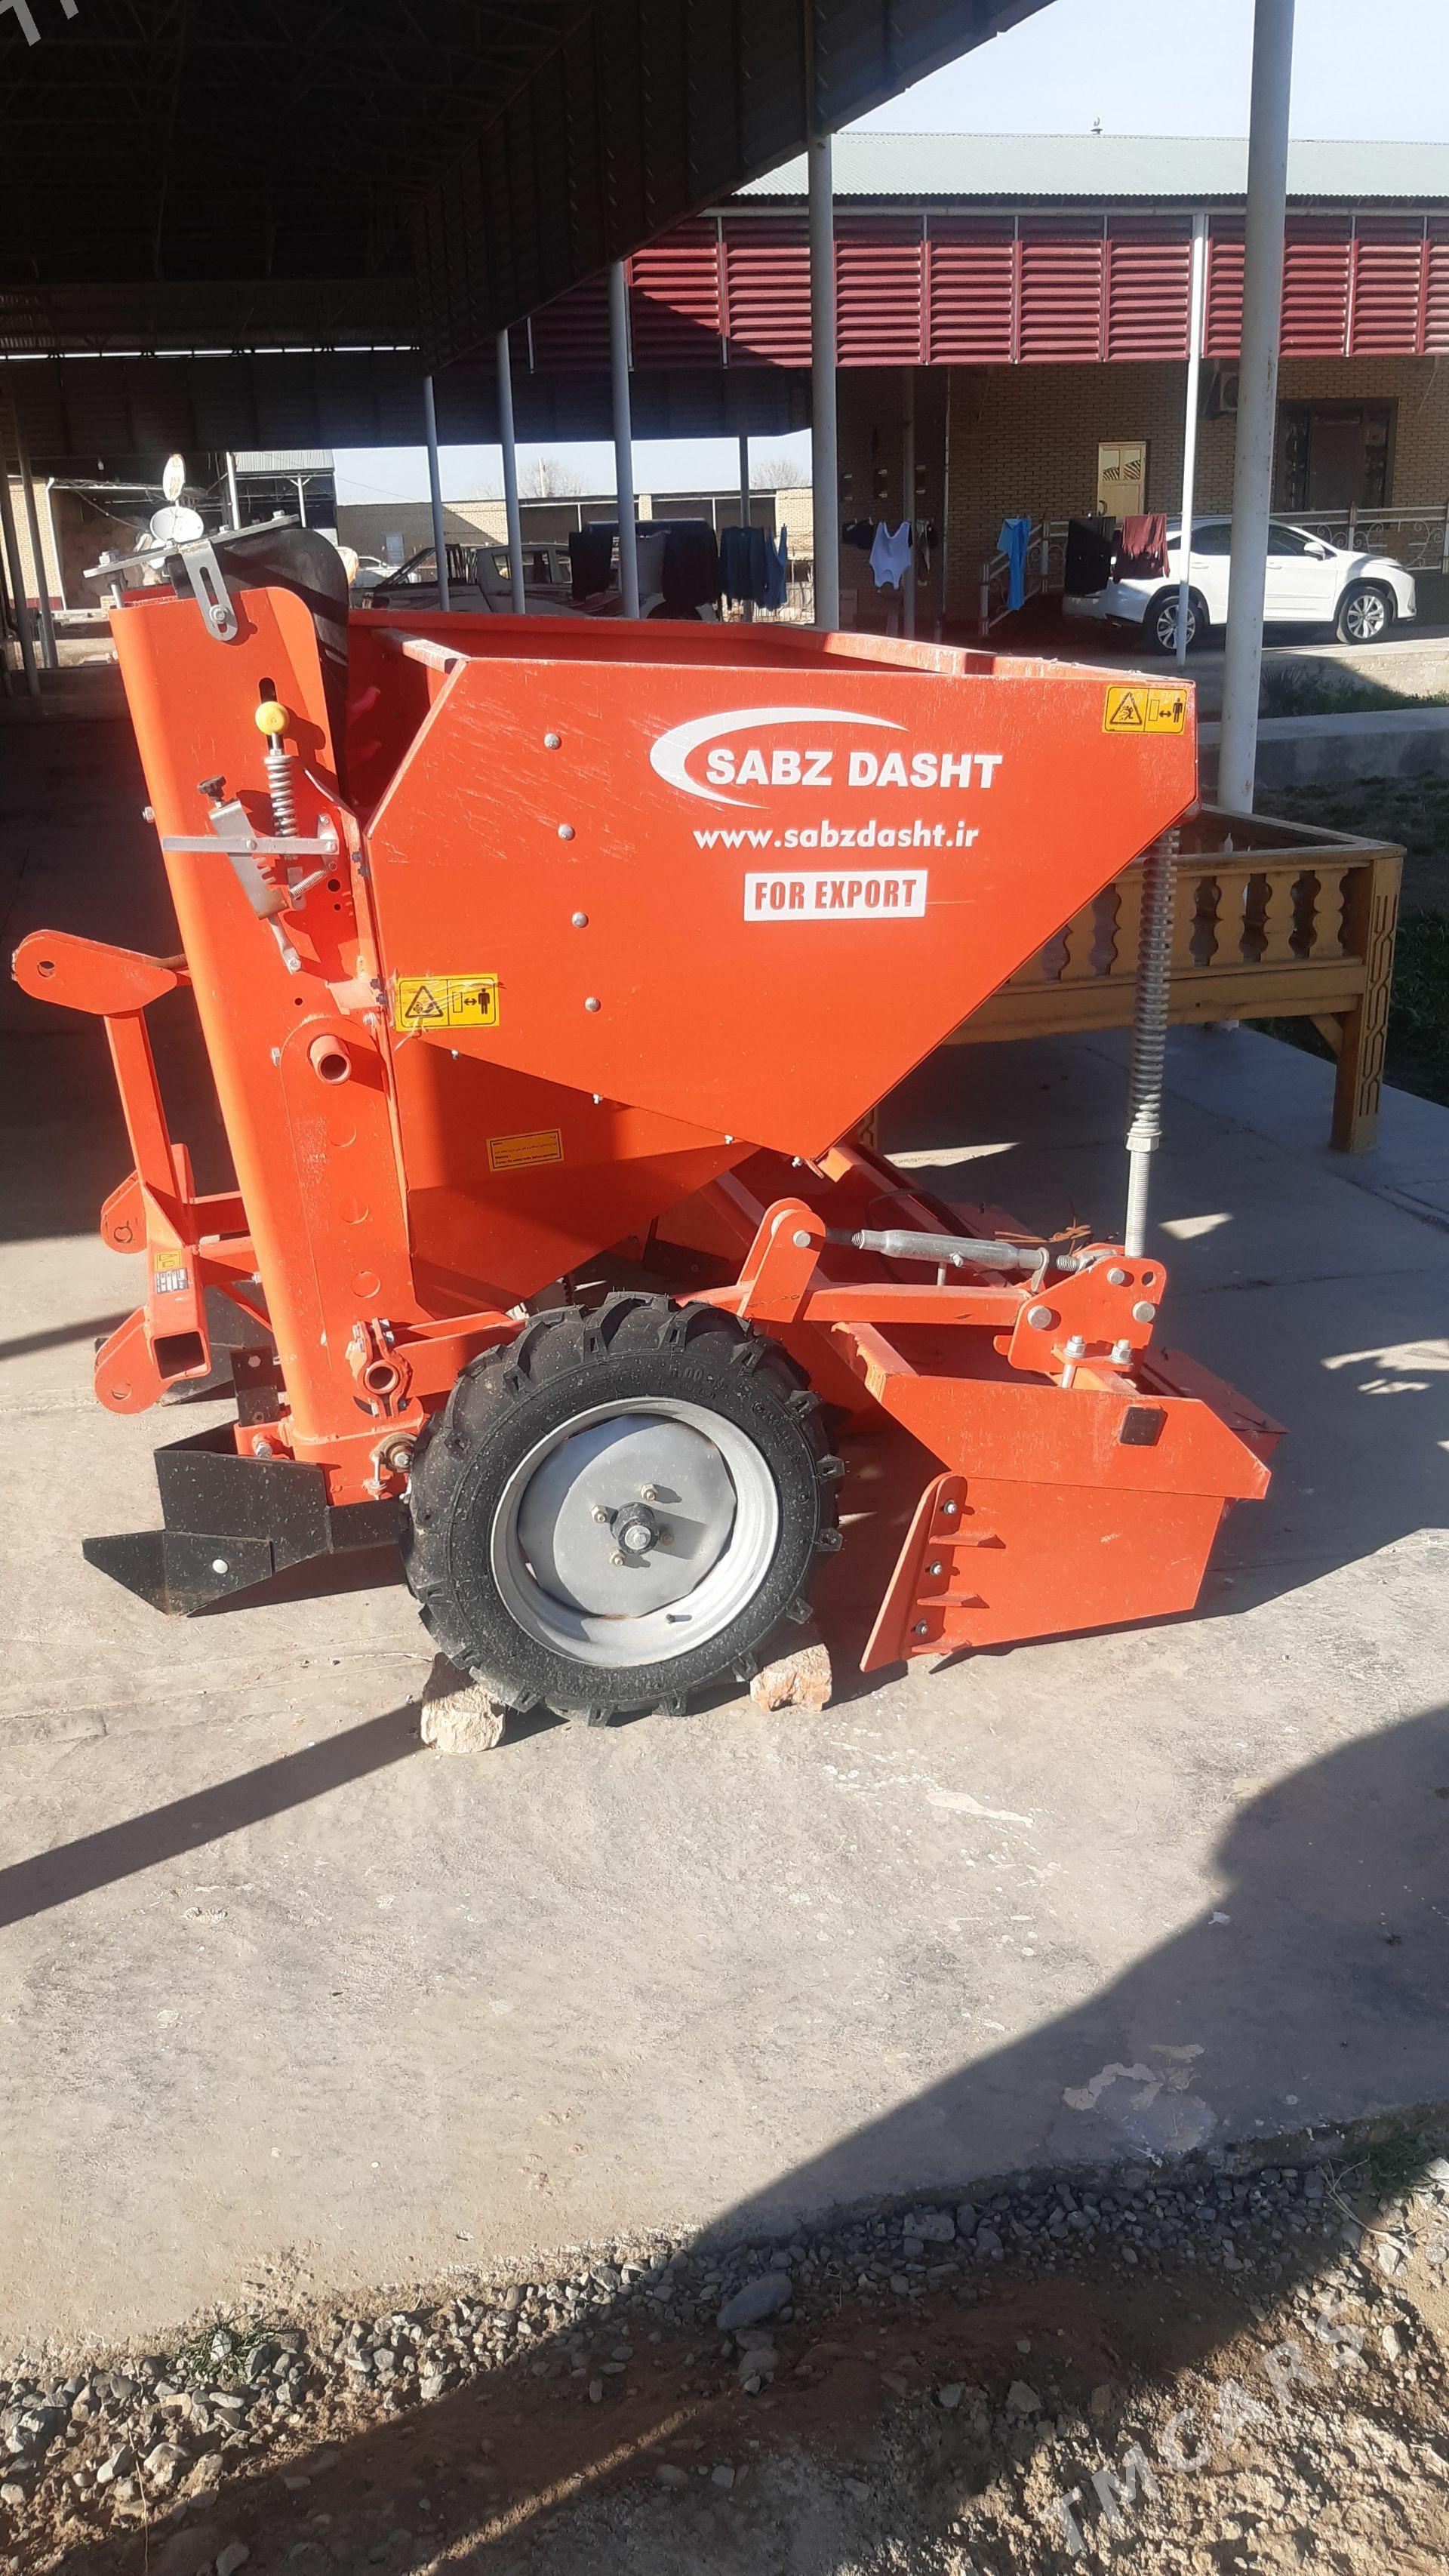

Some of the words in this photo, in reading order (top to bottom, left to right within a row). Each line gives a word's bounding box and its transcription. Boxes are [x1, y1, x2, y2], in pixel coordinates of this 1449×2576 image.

[706, 747, 833, 786] SABZ
[848, 750, 1004, 789] DASHT
[693, 819, 980, 849] www.sabzdasht.ir
[755, 881, 805, 909] FOR
[815, 879, 917, 909] EXPORT
